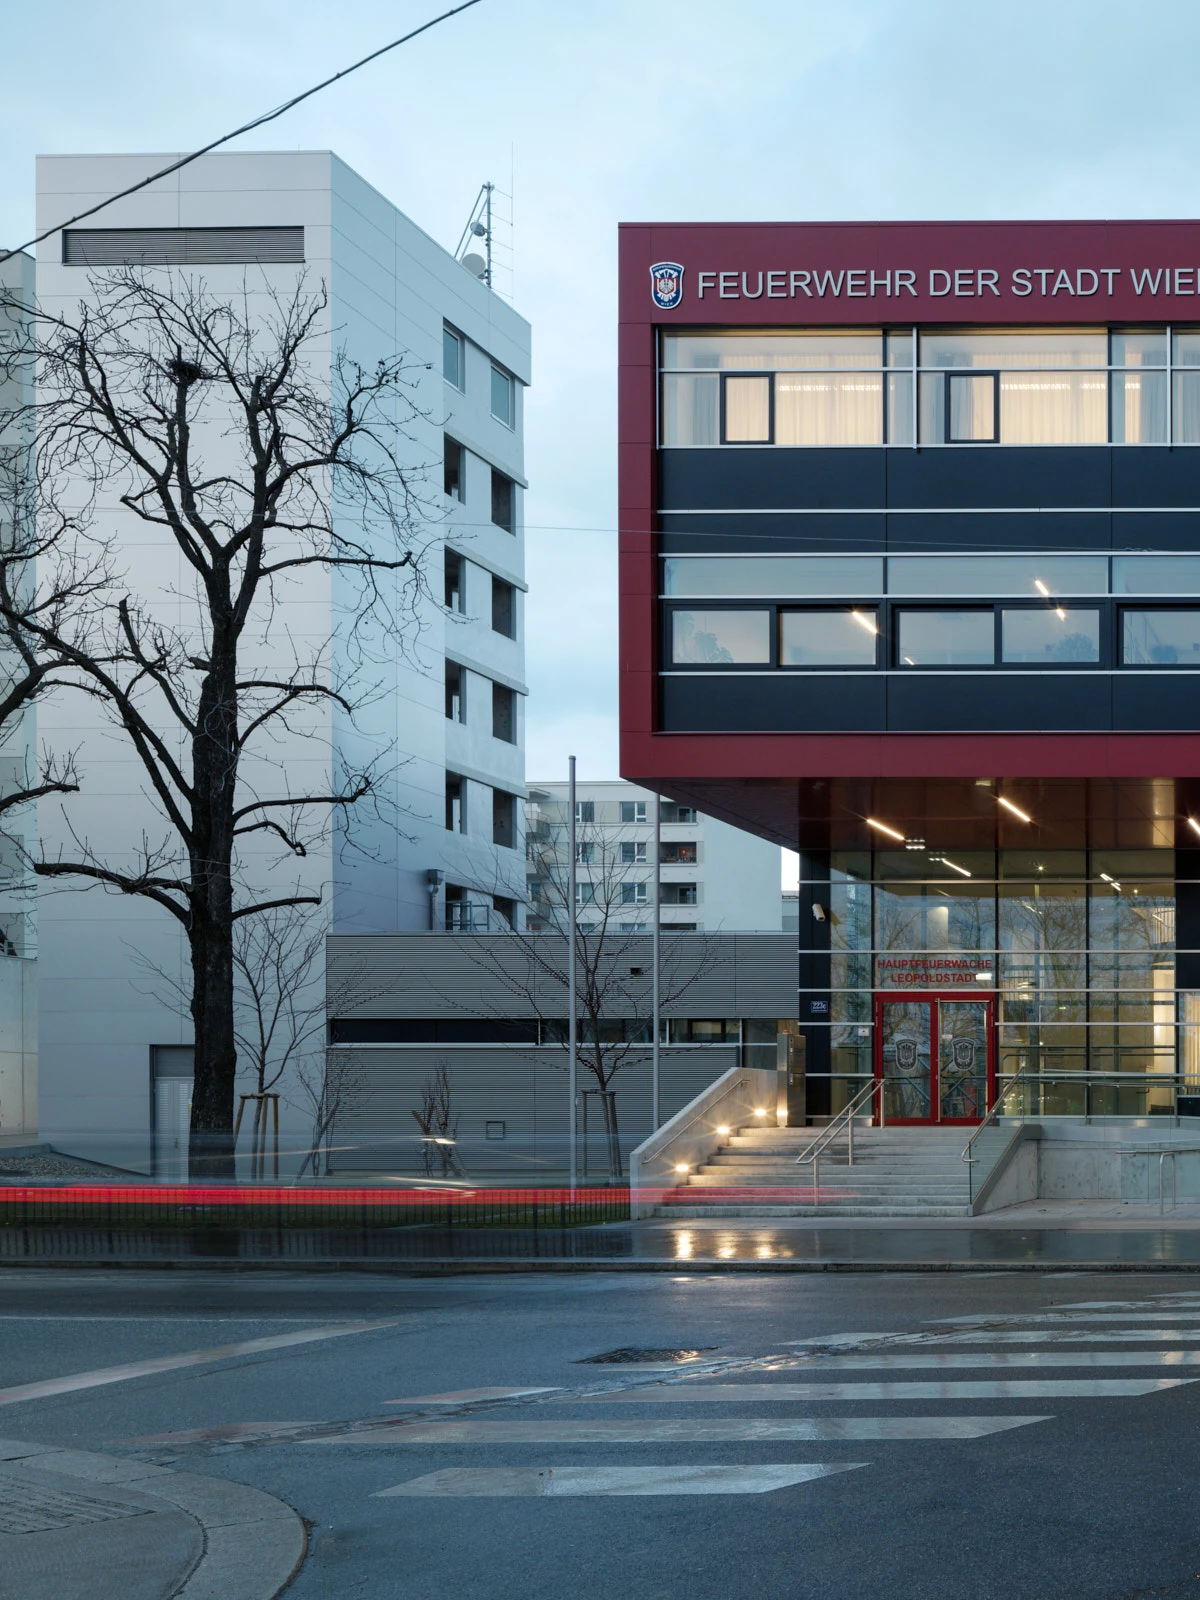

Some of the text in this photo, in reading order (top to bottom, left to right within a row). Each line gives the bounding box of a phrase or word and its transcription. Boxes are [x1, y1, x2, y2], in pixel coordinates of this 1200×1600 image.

[697, 269, 918, 299] FEUERWEHR
[929, 269, 1001, 297] DER
[1011, 268, 1122, 297] STADT
[877, 959, 992, 969] HAUPTFEUERWACHE
[891, 973, 980, 983] LEOPOLDSTADT
